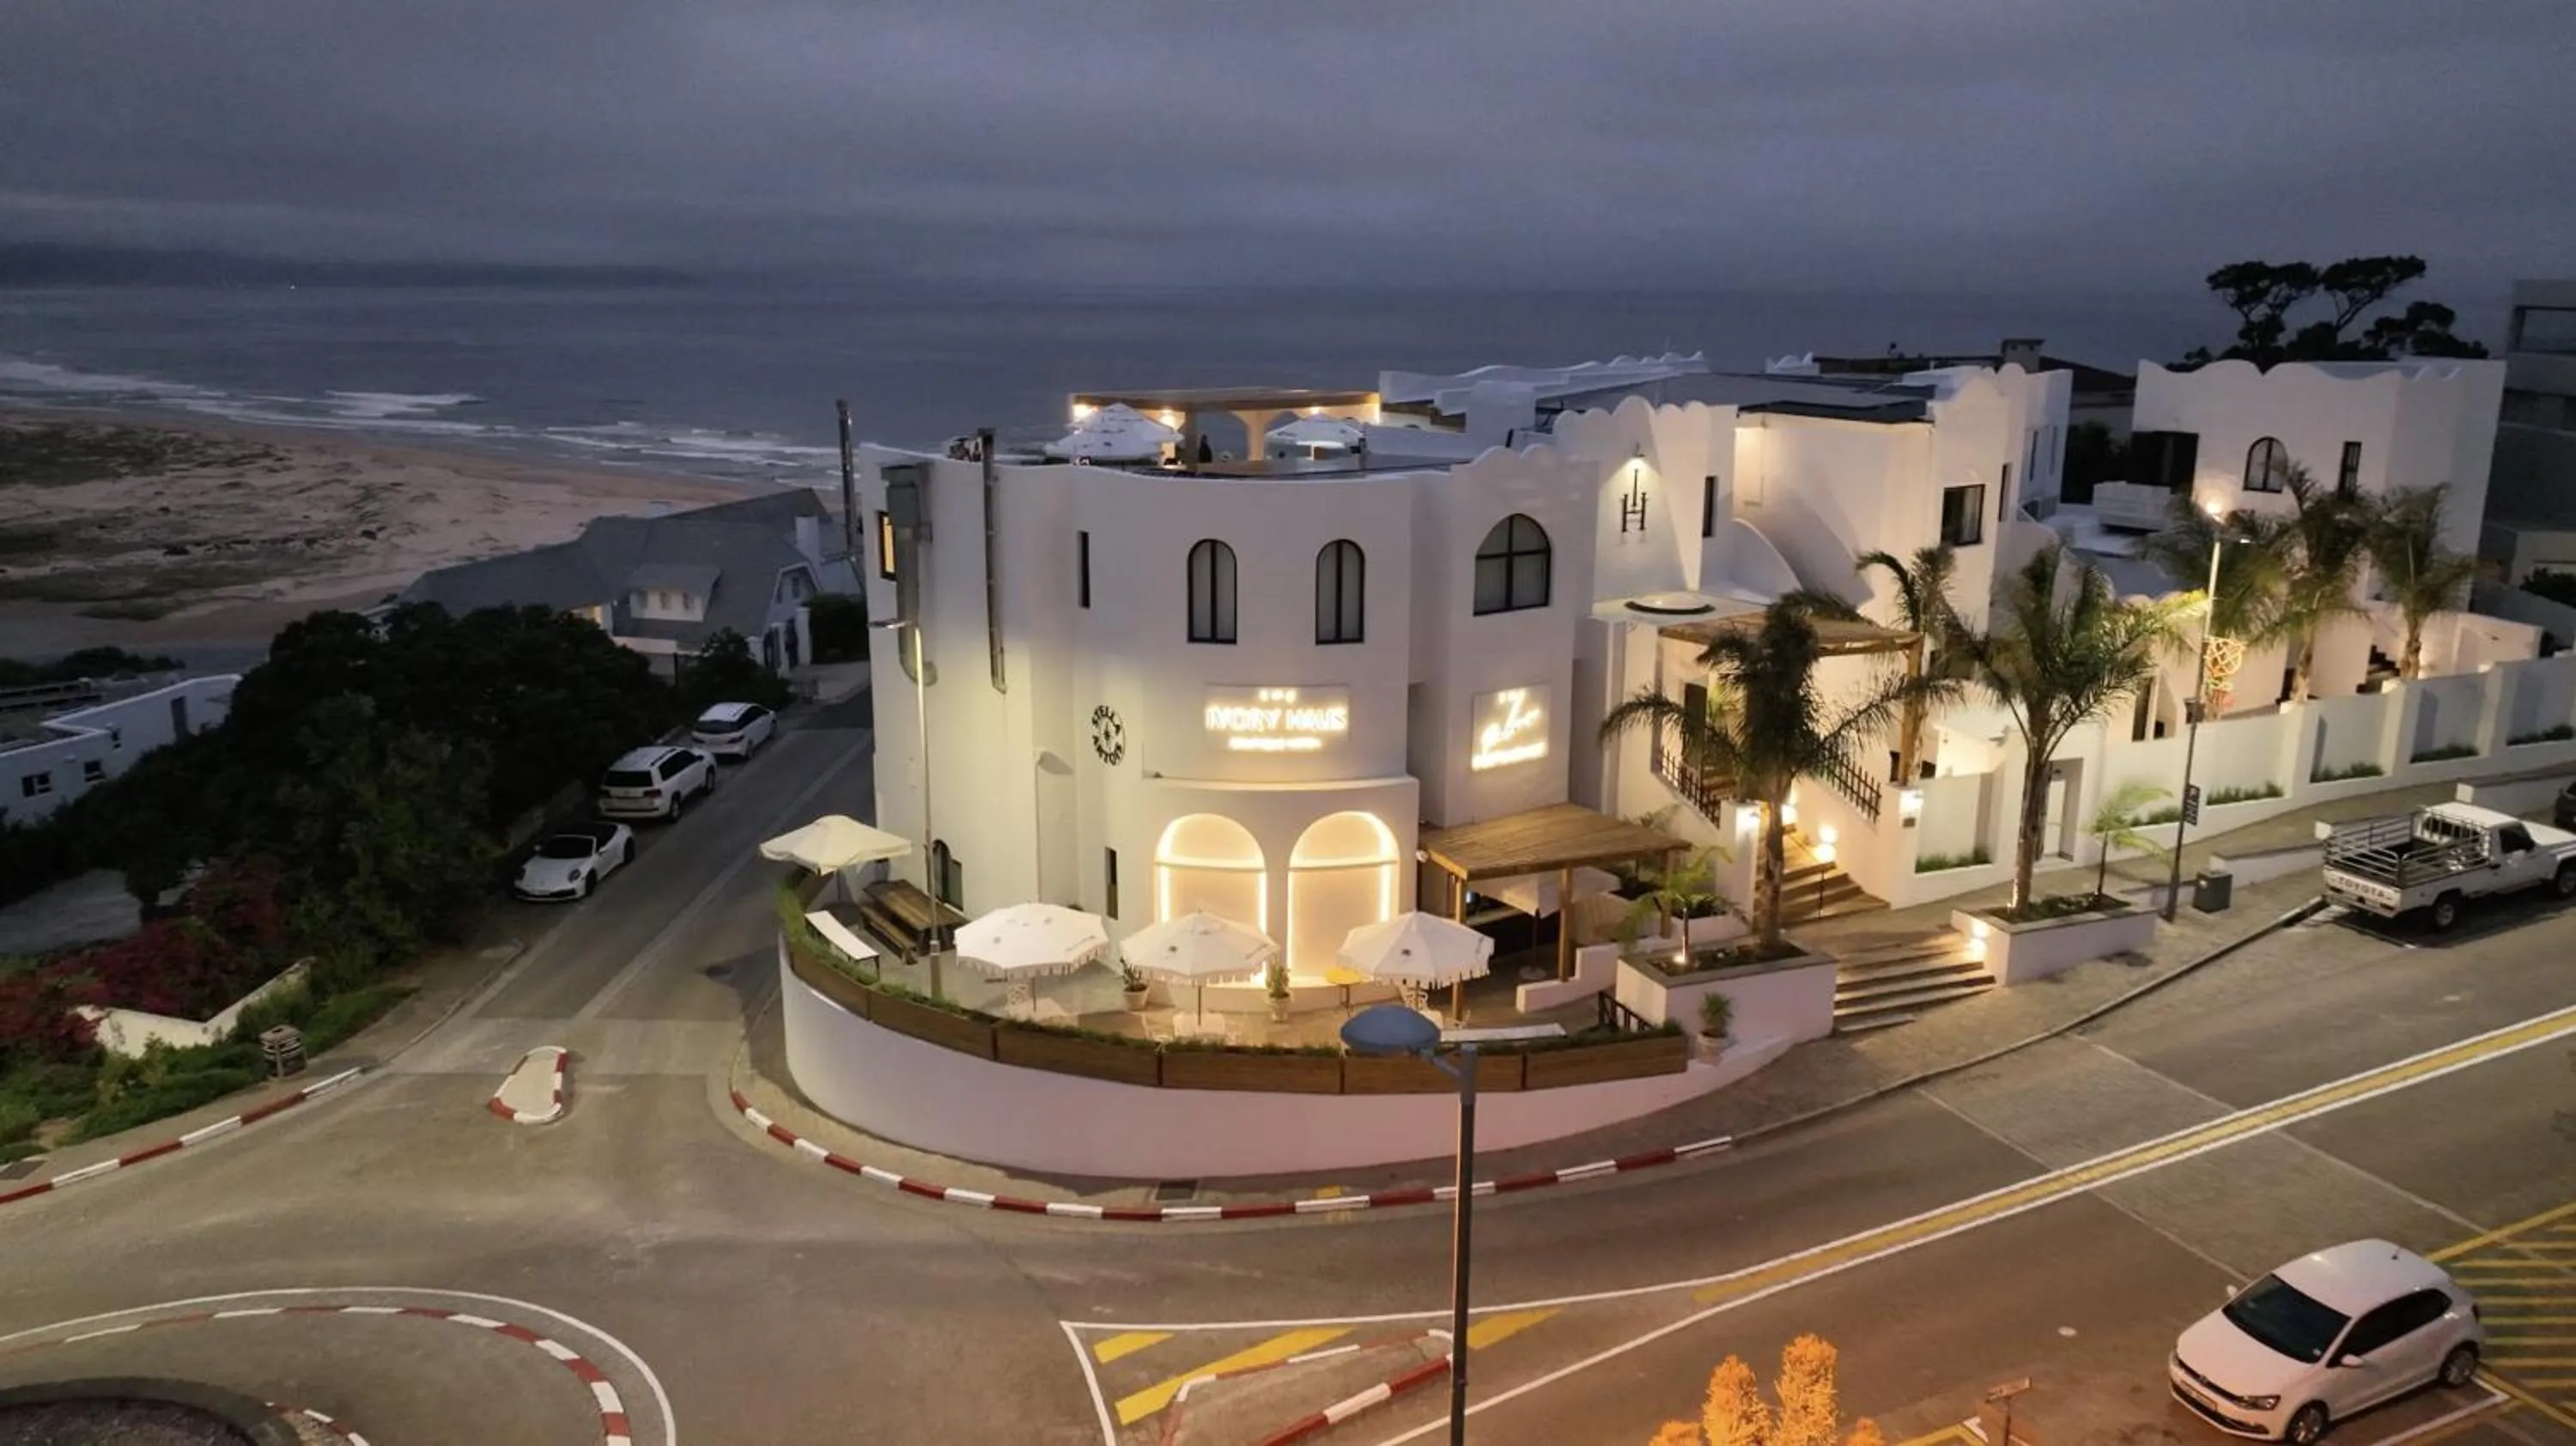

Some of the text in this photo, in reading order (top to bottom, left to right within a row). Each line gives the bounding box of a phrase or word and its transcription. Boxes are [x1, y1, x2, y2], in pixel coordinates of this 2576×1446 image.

[1206, 705, 1347, 731] IVORY HAUS
[2337, 876, 2385, 897] TOYOTA
